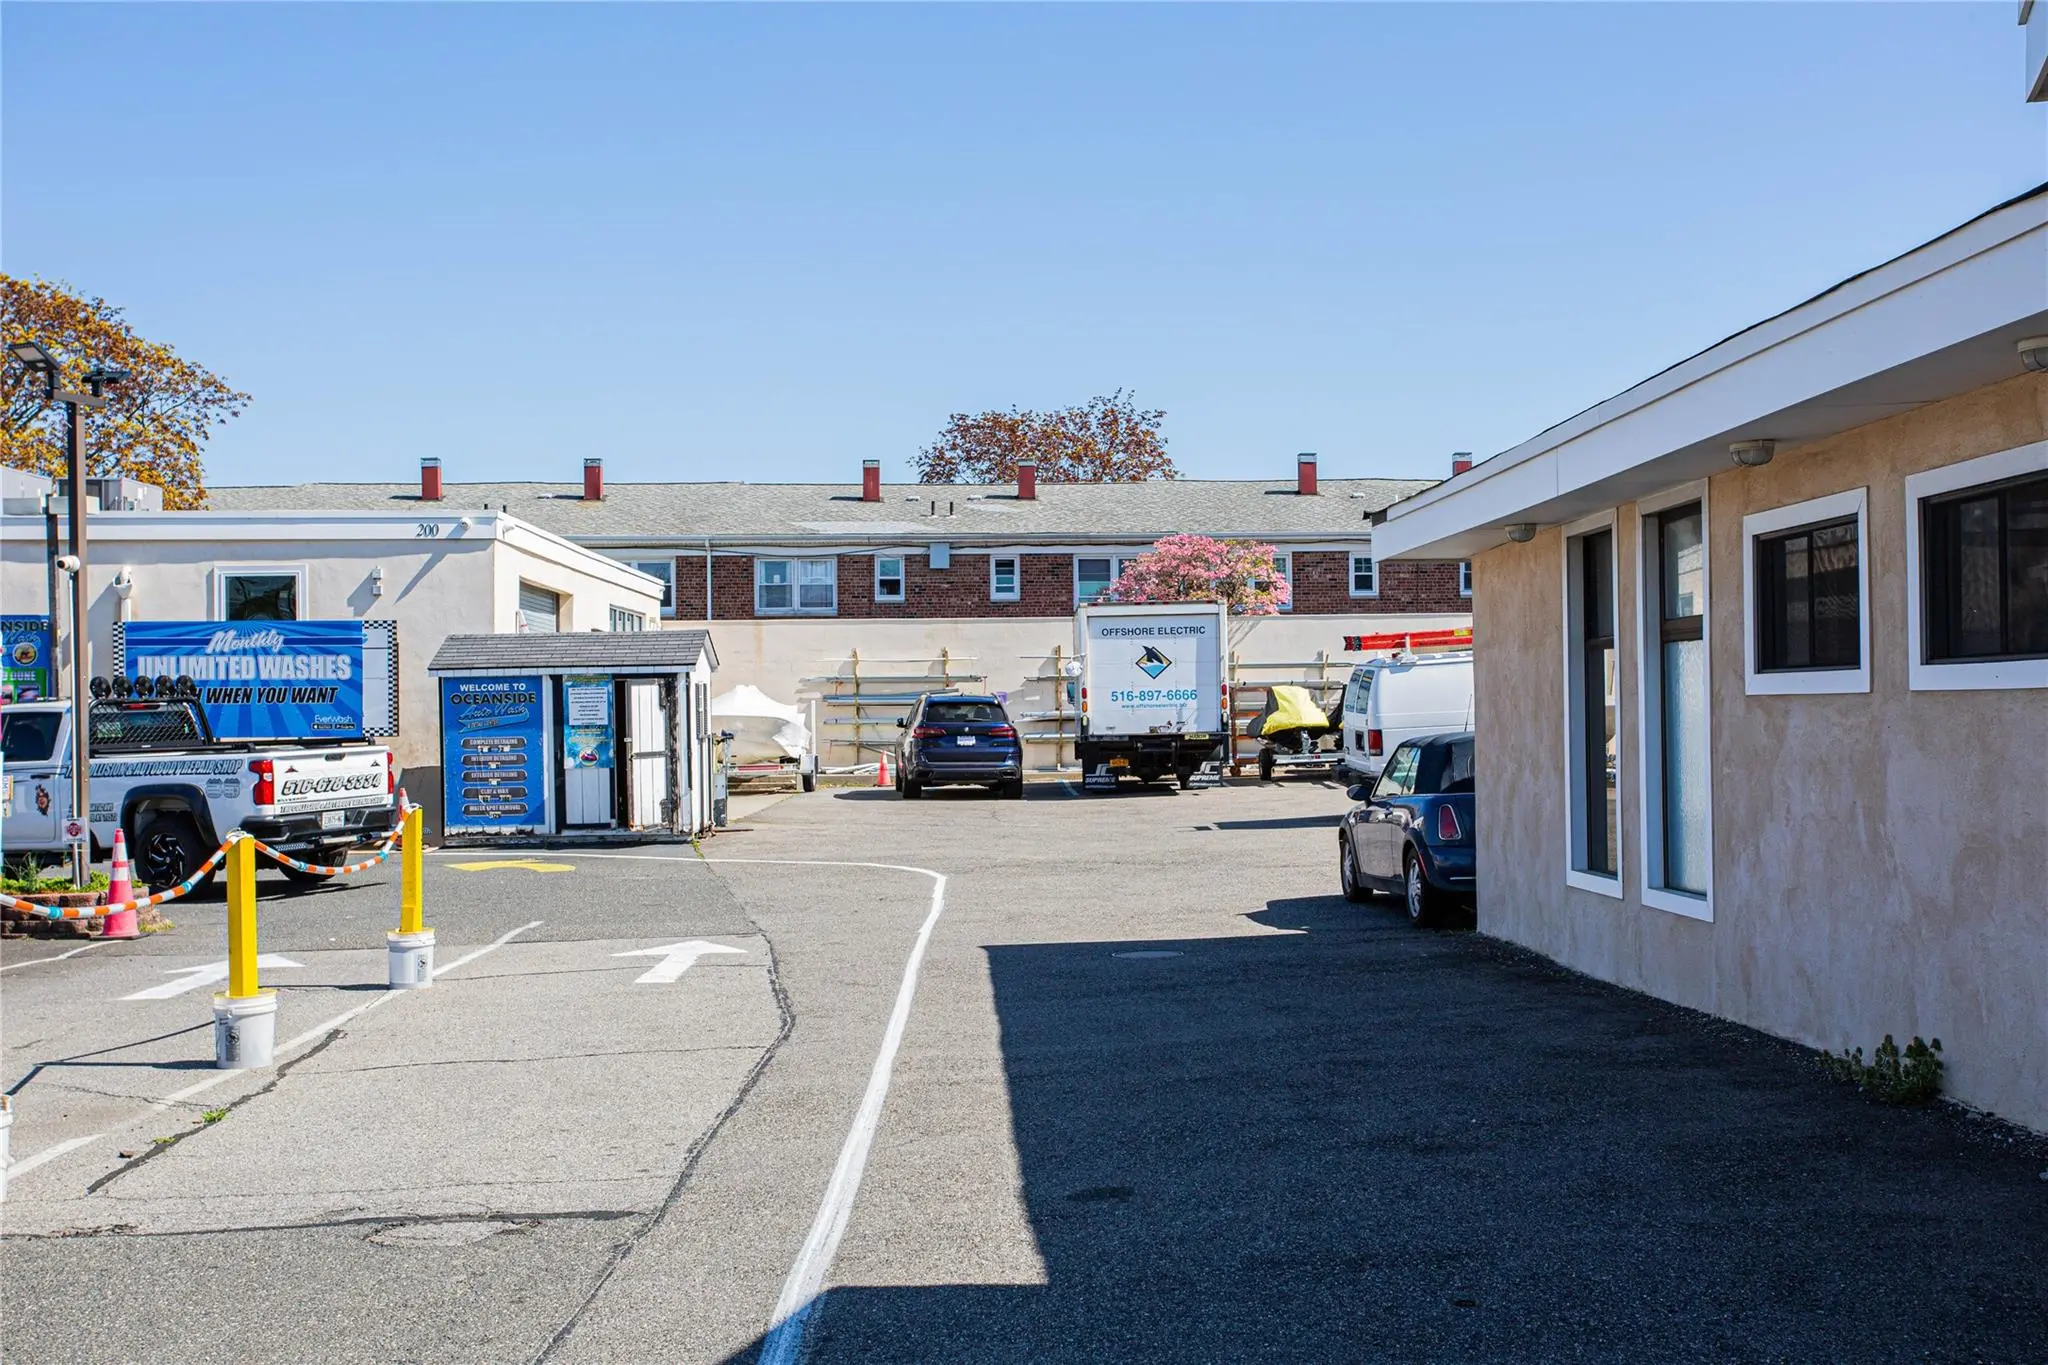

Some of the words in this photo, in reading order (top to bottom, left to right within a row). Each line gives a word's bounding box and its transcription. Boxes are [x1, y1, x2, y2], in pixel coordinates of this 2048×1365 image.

[415, 523, 440, 538] 200
[1101, 627, 1154, 637] OFFSHORE
[1157, 626, 1206, 635] ELECTRIC
[206, 628, 285, 655] Monthly
[137, 655, 256, 681] UNLIMITED
[258, 654, 352, 681] WASHES
[459, 683, 510, 692] WELCOME
[512, 683, 527, 691] TO
[205, 687, 251, 705] WHEN
[257, 687, 287, 704] YOU
[291, 686, 339, 704] WANT
[450, 691, 537, 705] OCEANSIDE
[1111, 689, 1198, 702] 516-897-6666
[314, 714, 353, 723] EverWash
[89, 762, 126, 778] OLLISION
[133, 760, 181, 776] AUTOBODY
[180, 759, 214, 775] REPAIR
[214, 759, 243, 774] SHOP
[281, 773, 383, 796] 516-678-3334
